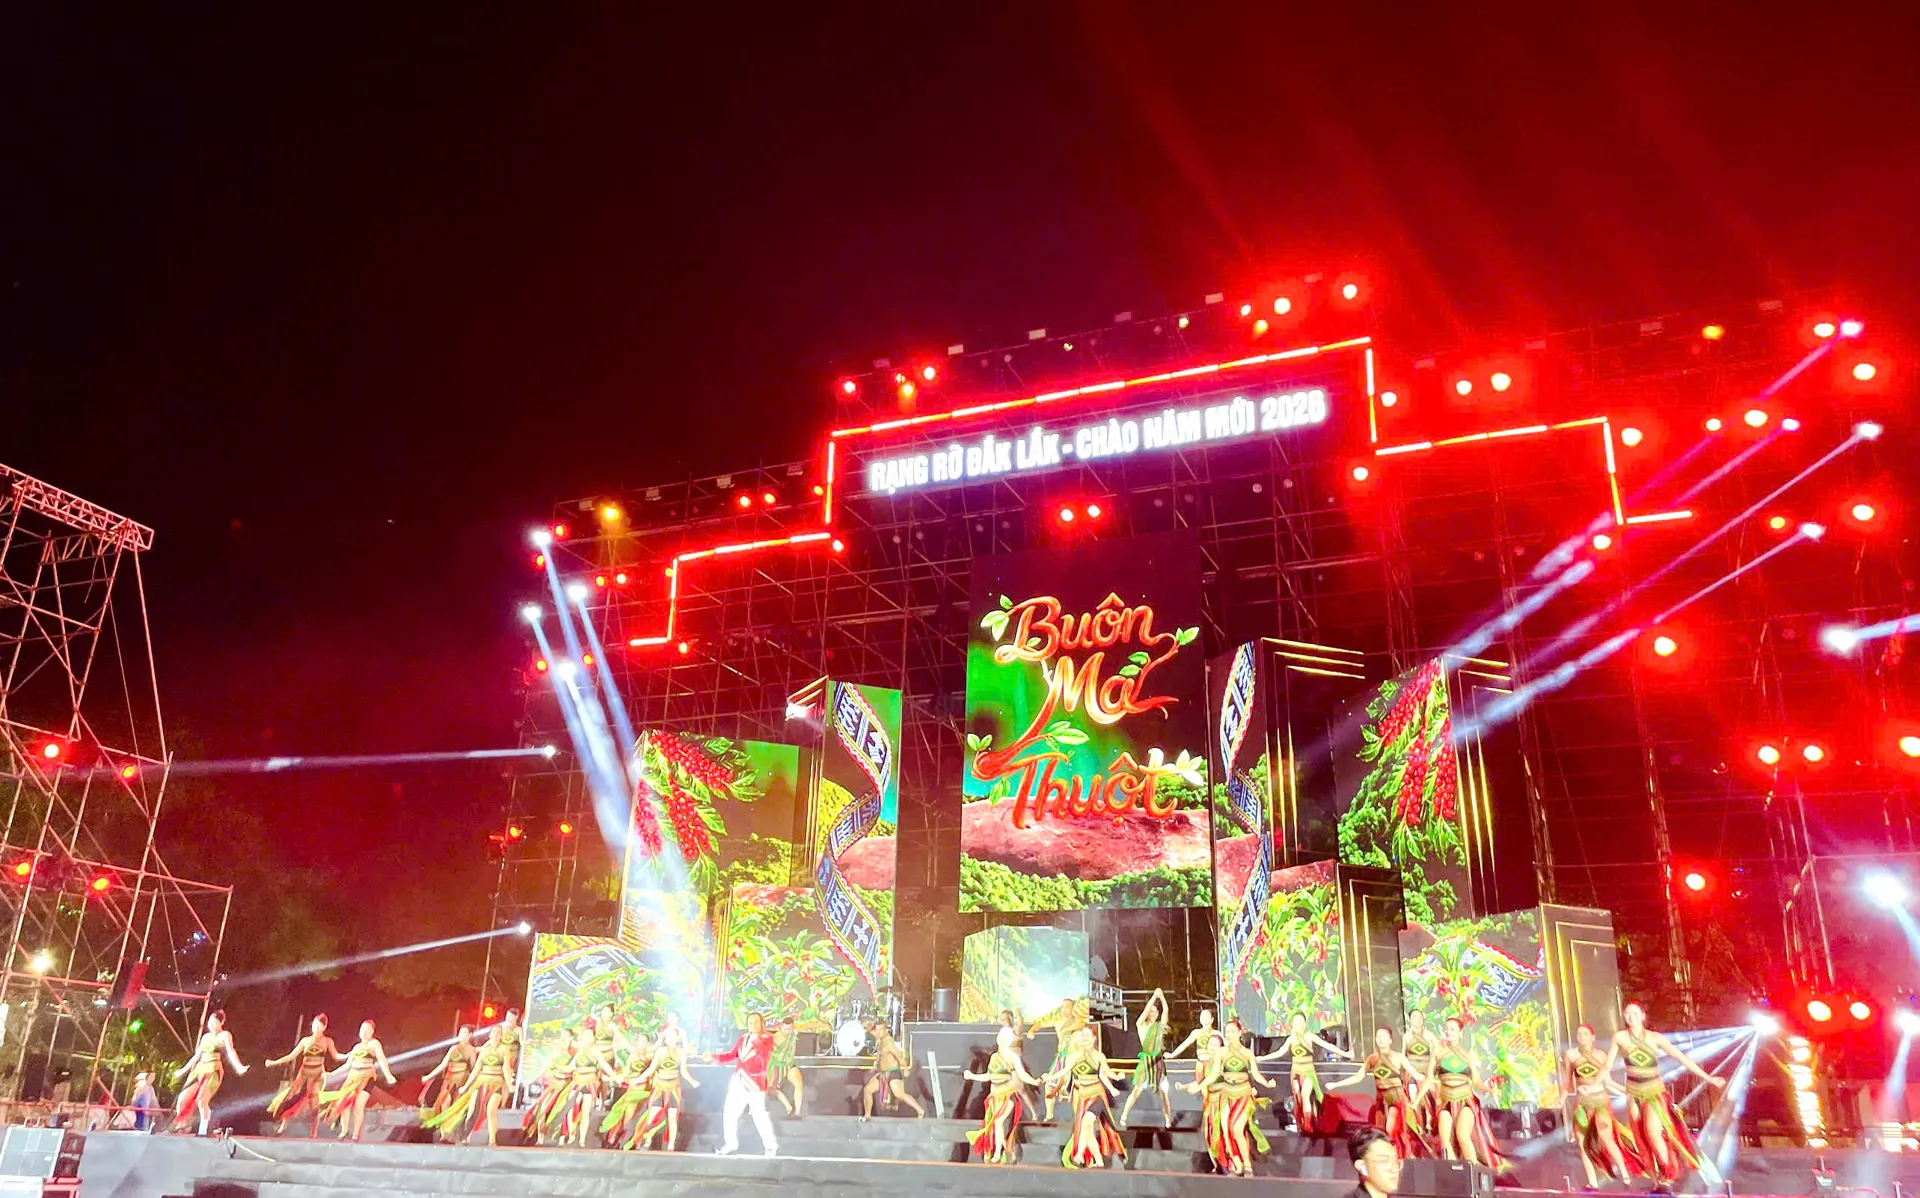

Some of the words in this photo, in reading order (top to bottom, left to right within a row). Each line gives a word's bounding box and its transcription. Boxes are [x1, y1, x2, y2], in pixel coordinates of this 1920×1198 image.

[870, 455, 929, 495] RẠNG
[1016, 426, 1061, 470] LẮK
[1076, 417, 1140, 460] CHÀO
[1143, 408, 1202, 450] NĂM
[1204, 396, 1256, 440] MỚI
[994, 591, 1180, 664] Buôn
[1040, 651, 1180, 725] Ma
[1000, 751, 1178, 830] Thuột
